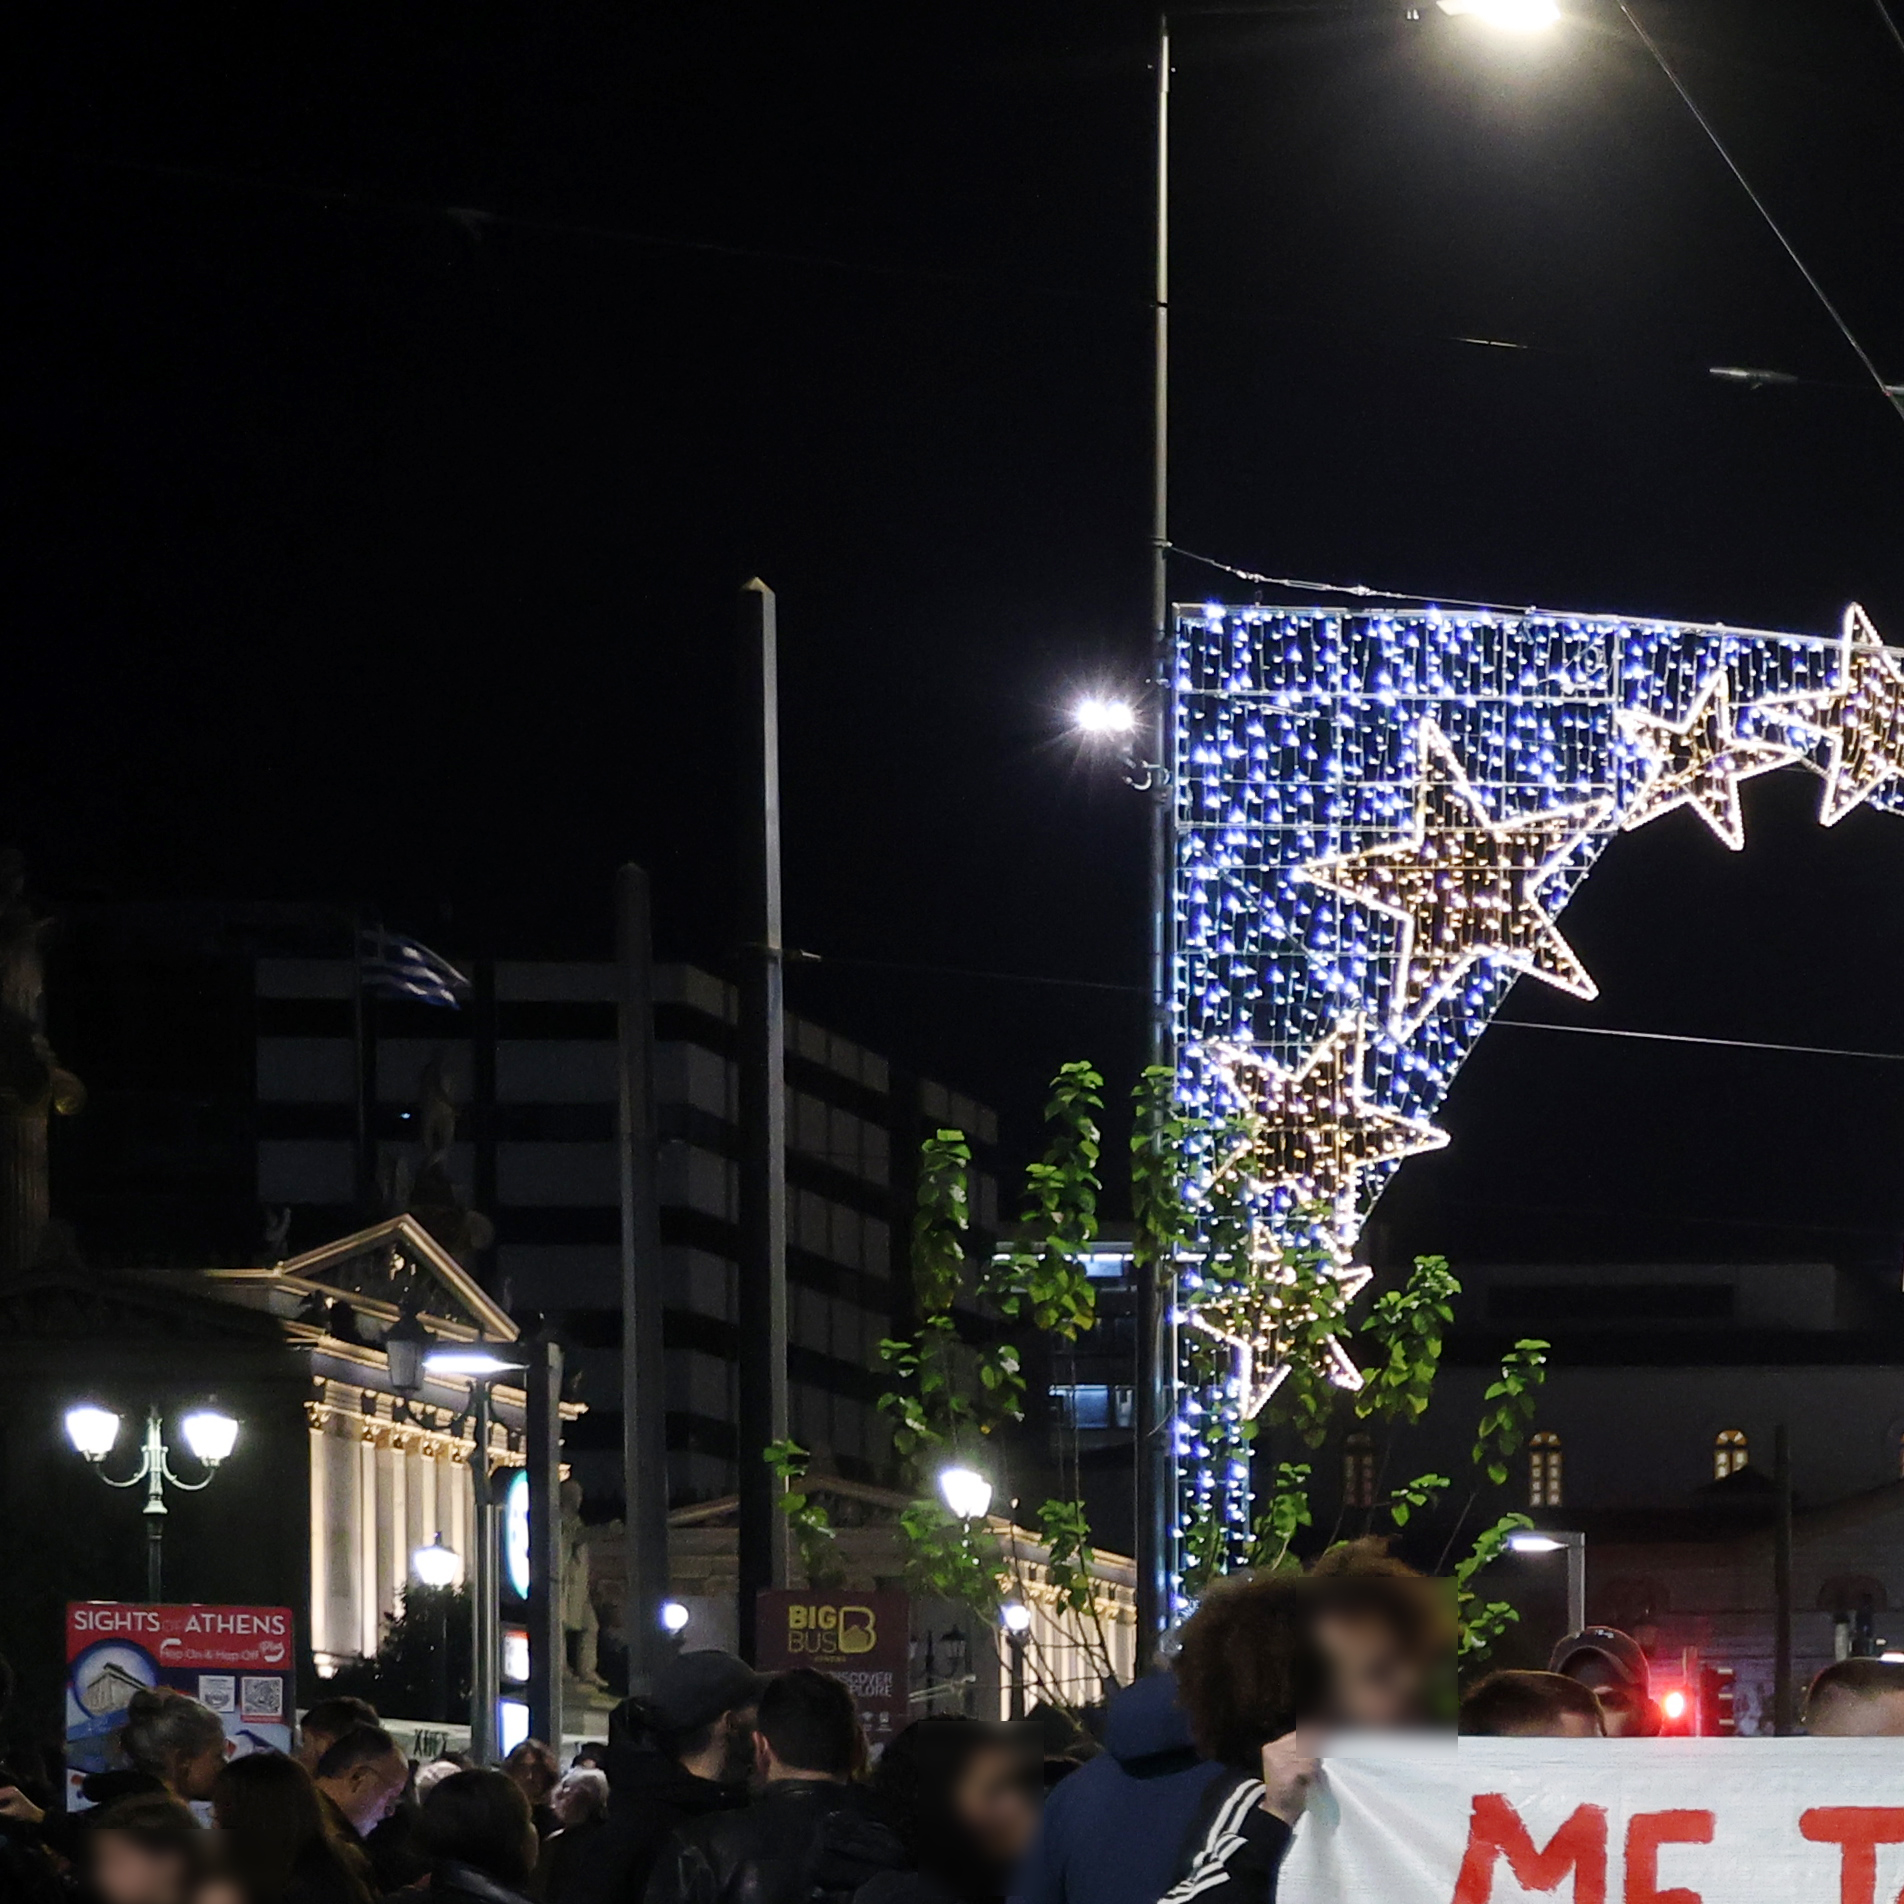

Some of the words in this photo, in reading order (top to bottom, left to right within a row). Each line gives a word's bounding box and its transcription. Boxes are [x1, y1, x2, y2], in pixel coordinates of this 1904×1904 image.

[73, 1610, 161, 1632] SIGHTS
[184, 1612, 286, 1636] ATHENS
[788, 1605, 838, 1630] BIG
[787, 1630, 838, 1653] BUS
[834, 1671, 893, 1684] ISCOVER
